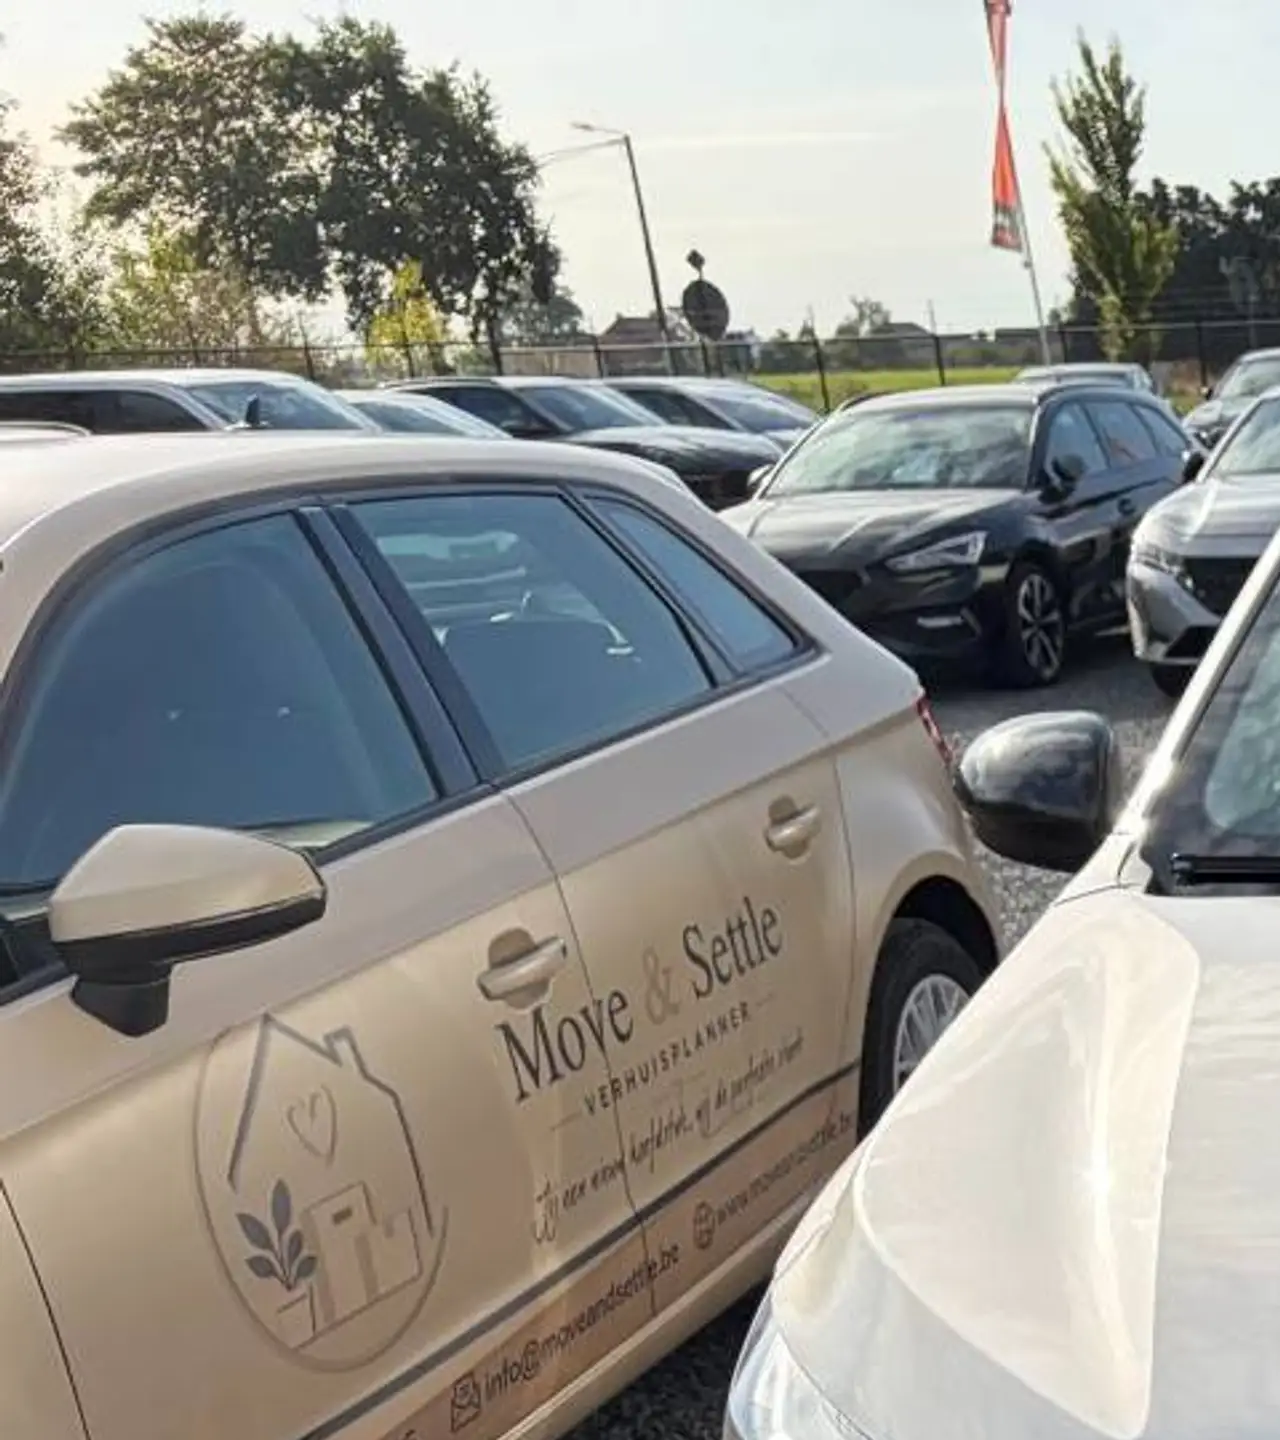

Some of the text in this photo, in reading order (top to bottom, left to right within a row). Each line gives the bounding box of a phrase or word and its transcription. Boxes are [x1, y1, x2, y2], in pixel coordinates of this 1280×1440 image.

[495, 896, 783, 1103] Move & Settle
[584, 1002, 751, 1114] VERHUISPLANNER
[485, 1244, 680, 1401] info@moveandsettle.be
